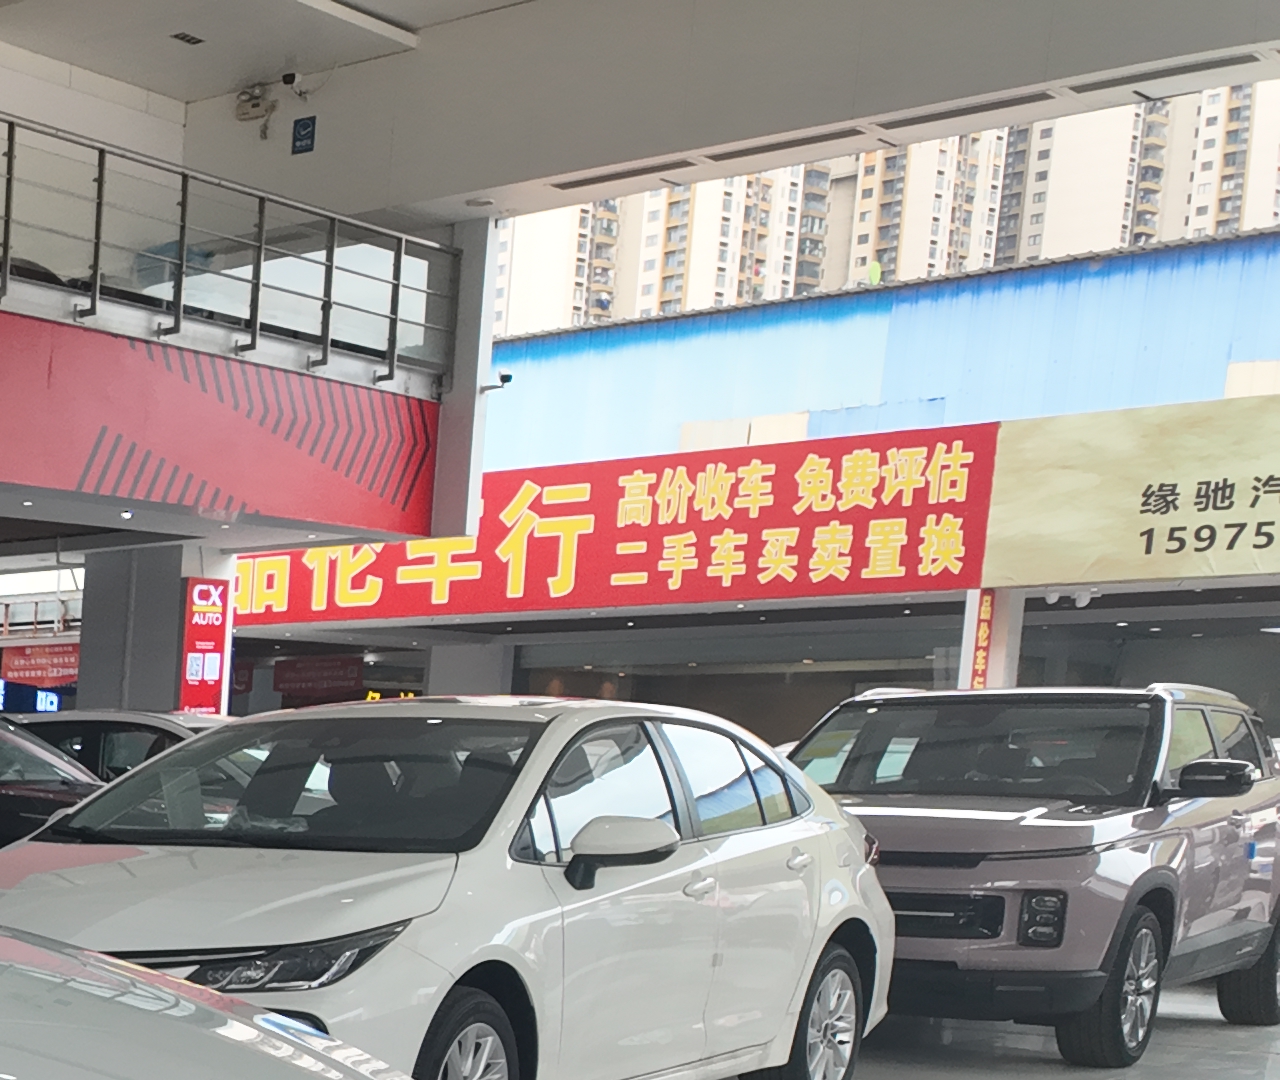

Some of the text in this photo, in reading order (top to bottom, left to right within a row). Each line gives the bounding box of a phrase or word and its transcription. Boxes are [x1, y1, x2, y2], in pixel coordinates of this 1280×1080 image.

[616, 439, 974, 528] 高价收车 免费评估
[610, 513, 965, 591] 二手车买卖置换
[1139, 520, 1276, 556] 15975
[192, 583, 225, 607] CX
[191, 612, 223, 626] AUTO
